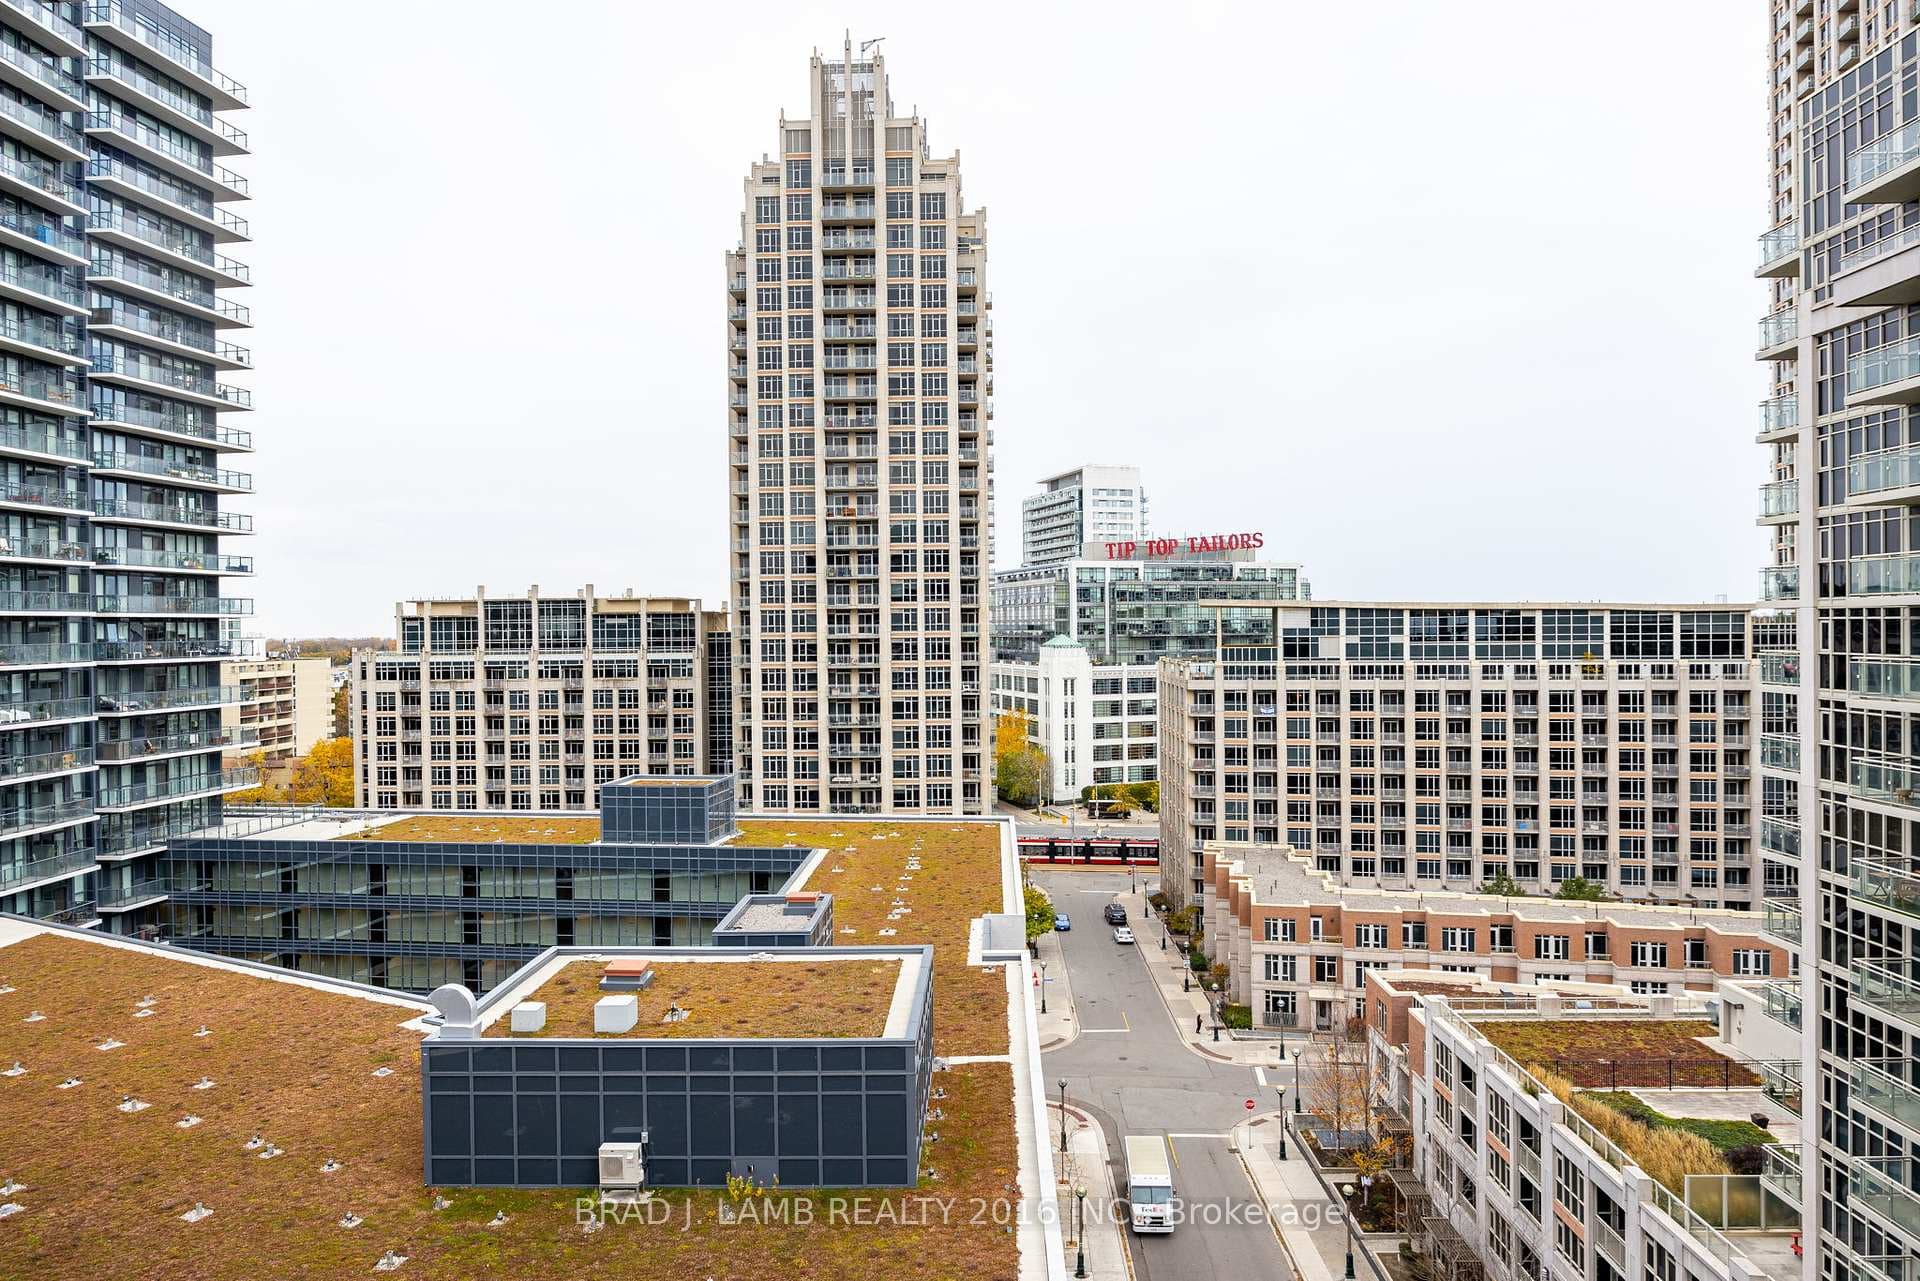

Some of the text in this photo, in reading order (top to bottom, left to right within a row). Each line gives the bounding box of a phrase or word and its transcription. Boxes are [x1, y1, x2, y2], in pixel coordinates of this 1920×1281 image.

[1105, 532, 1264, 560] TIP TOP TAILORS
